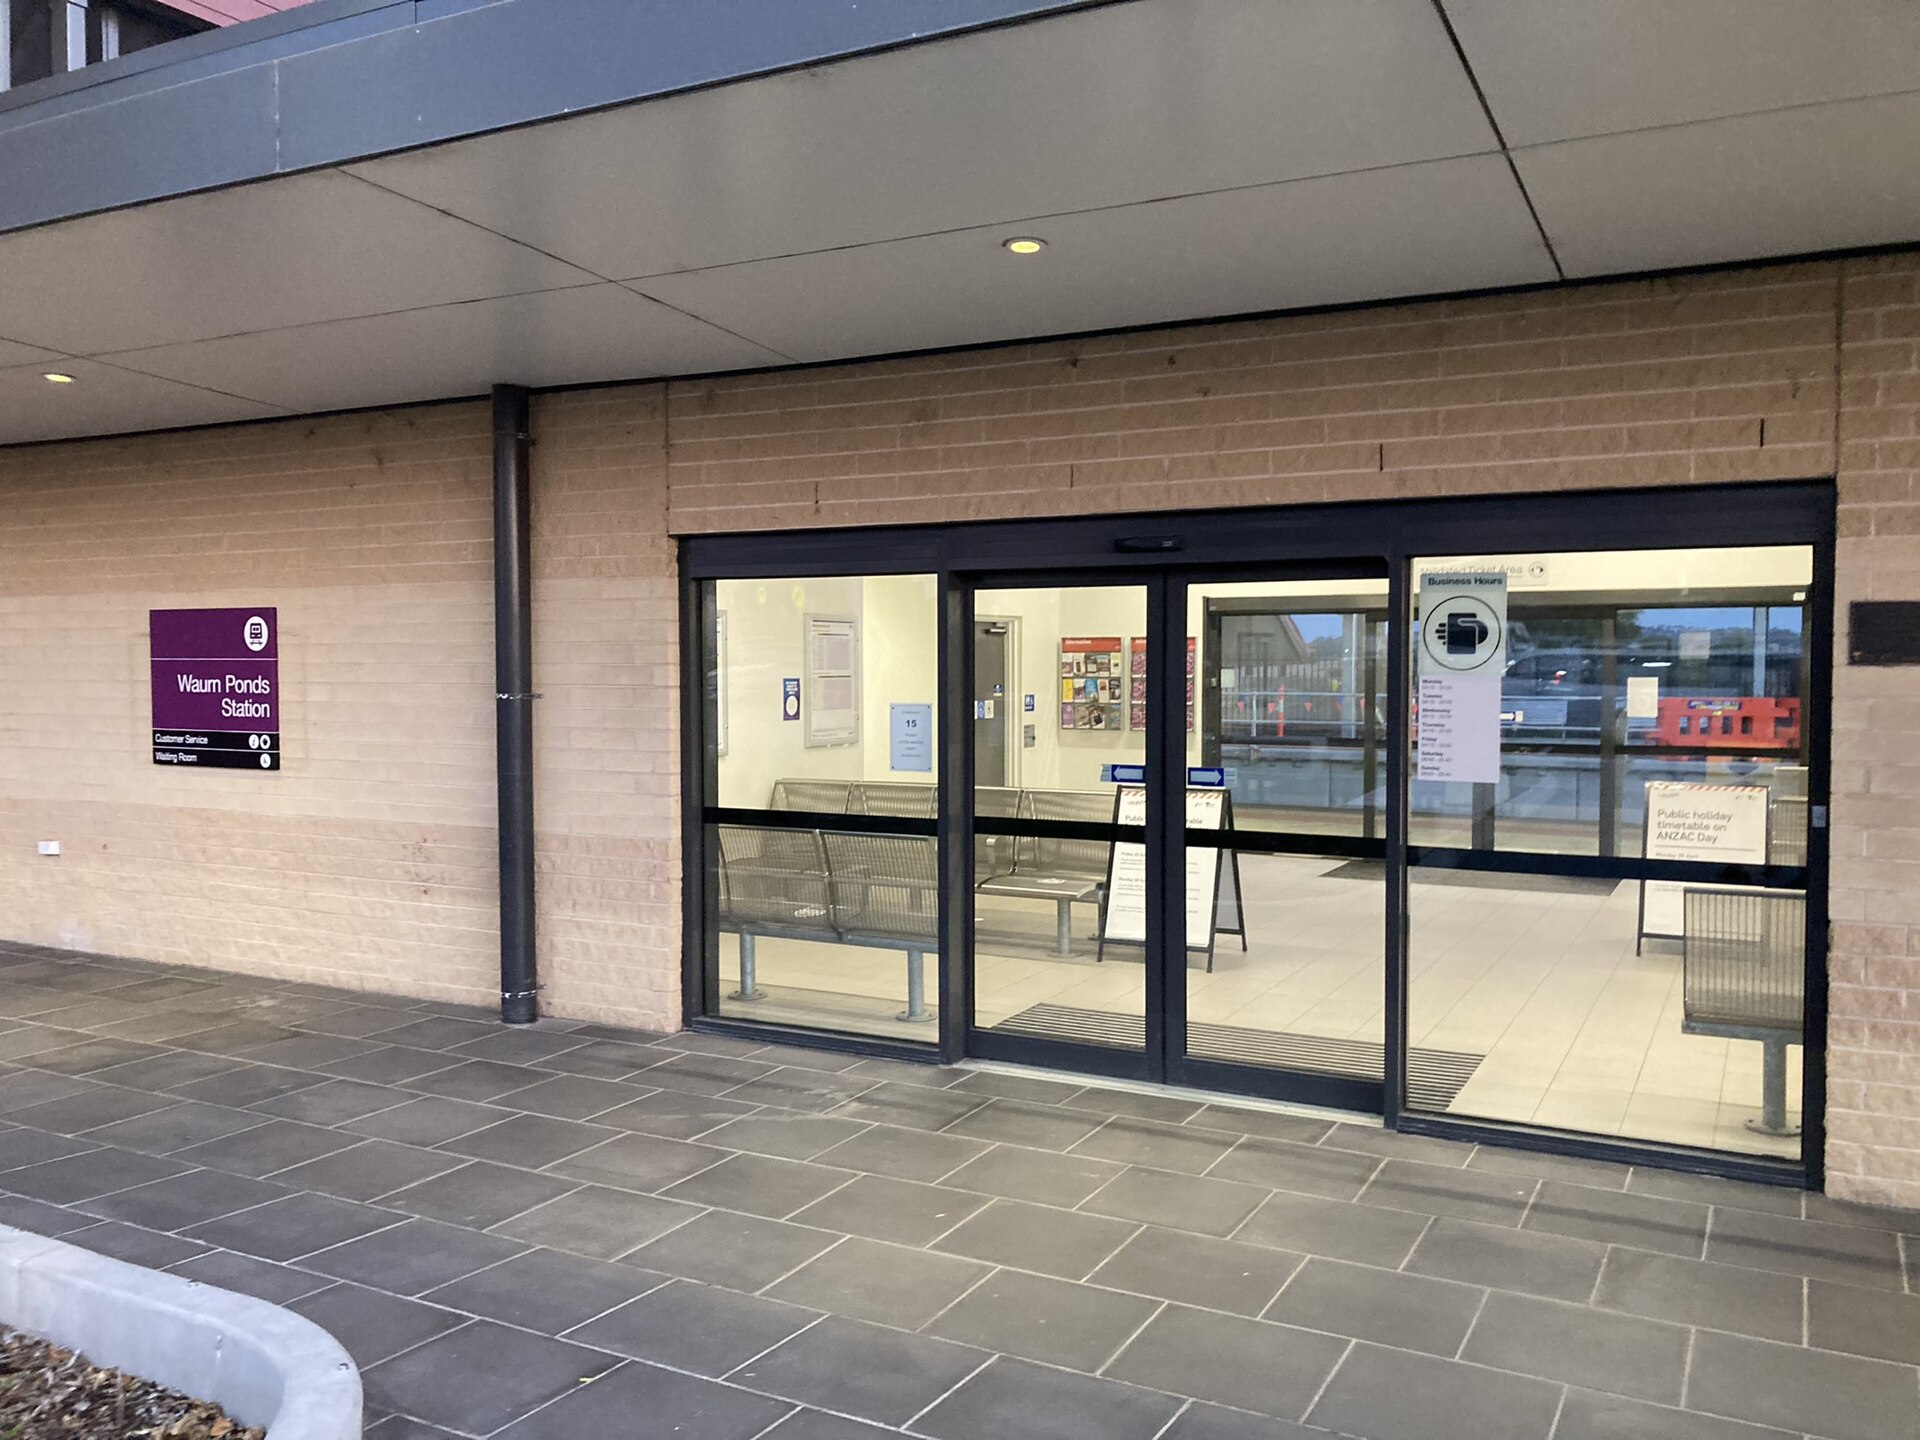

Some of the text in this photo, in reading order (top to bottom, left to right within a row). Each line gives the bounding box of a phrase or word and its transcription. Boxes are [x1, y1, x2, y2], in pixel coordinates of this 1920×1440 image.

[1499, 564, 1523, 574] Area
[1428, 576, 1503, 586] Business Hours
[177, 674, 271, 694] Waurn Ponds
[221, 697, 270, 718] Station
[905, 719, 917, 728] 15
[155, 733, 209, 745] Customer Service
[155, 751, 198, 763] Waiting Room
[1125, 814, 1144, 822] Public
[1657, 808, 1733, 824] Public holiday
[1657, 820, 1727, 832] timetable on
[1656, 831, 1719, 845] ANZAC Day
